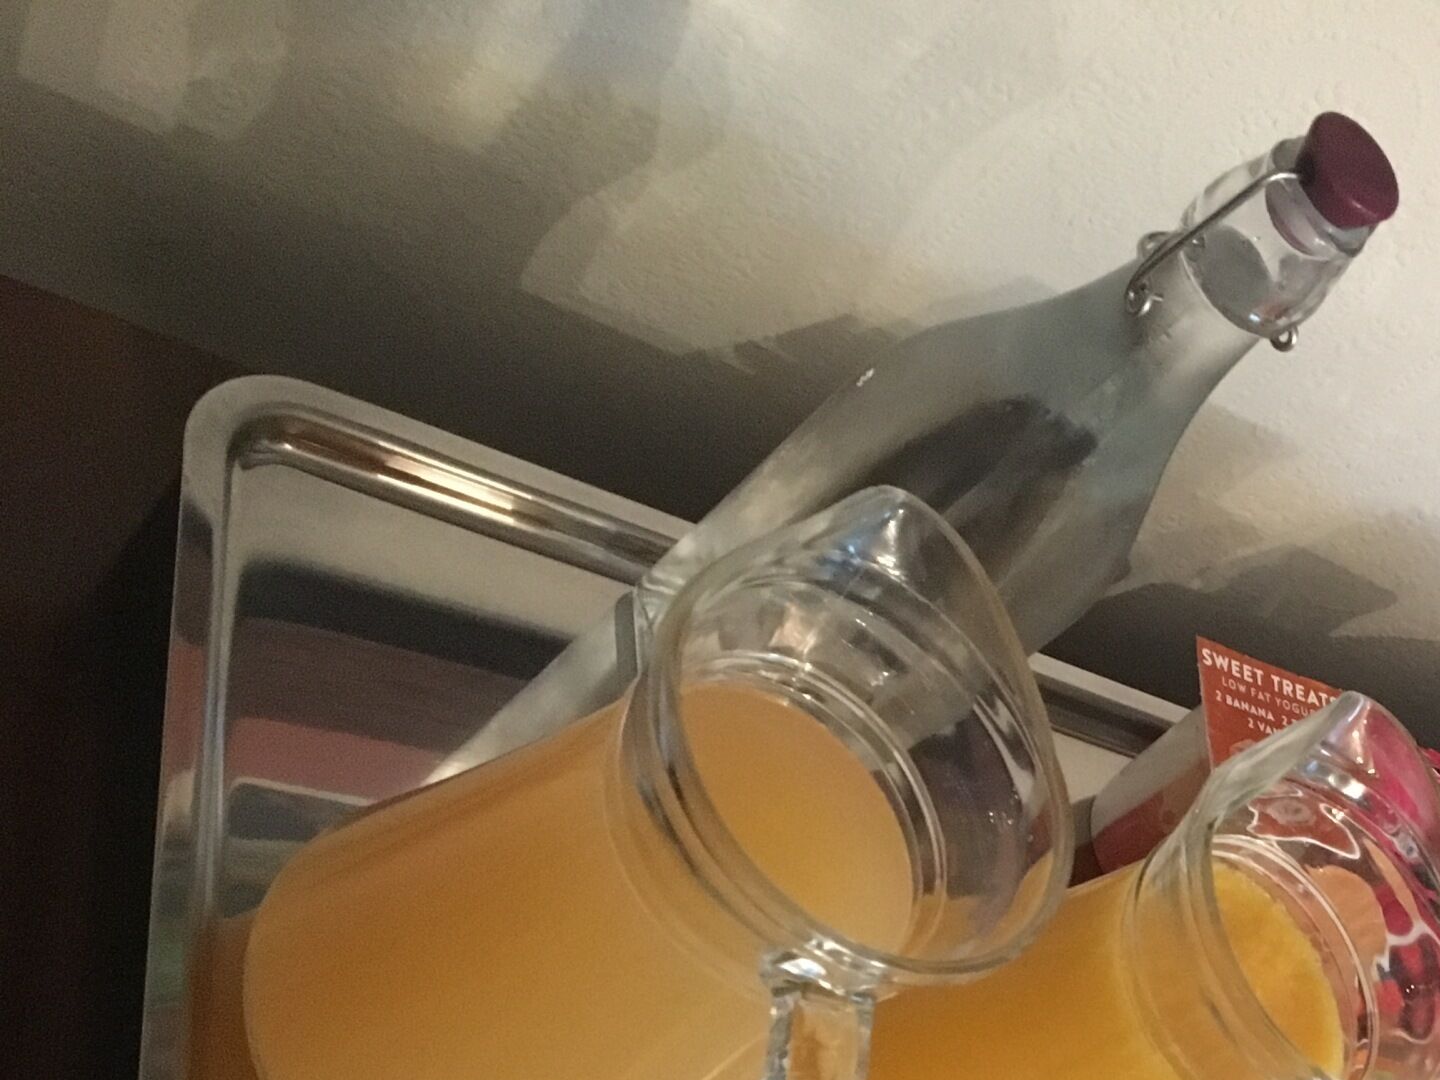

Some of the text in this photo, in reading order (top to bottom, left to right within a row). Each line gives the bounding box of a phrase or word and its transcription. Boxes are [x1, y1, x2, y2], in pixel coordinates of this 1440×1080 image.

[1201, 648, 1264, 686] SWEET
[1222, 677, 1247, 694] LOW
[1250, 689, 1271, 703] FAT
[1215, 690, 1223, 702] 2
[1226, 694, 1276, 722] BANANA
[1281, 715, 1288, 726] 2
[1247, 717, 1254, 729] 2
[1257, 720, 1276, 735] VA
